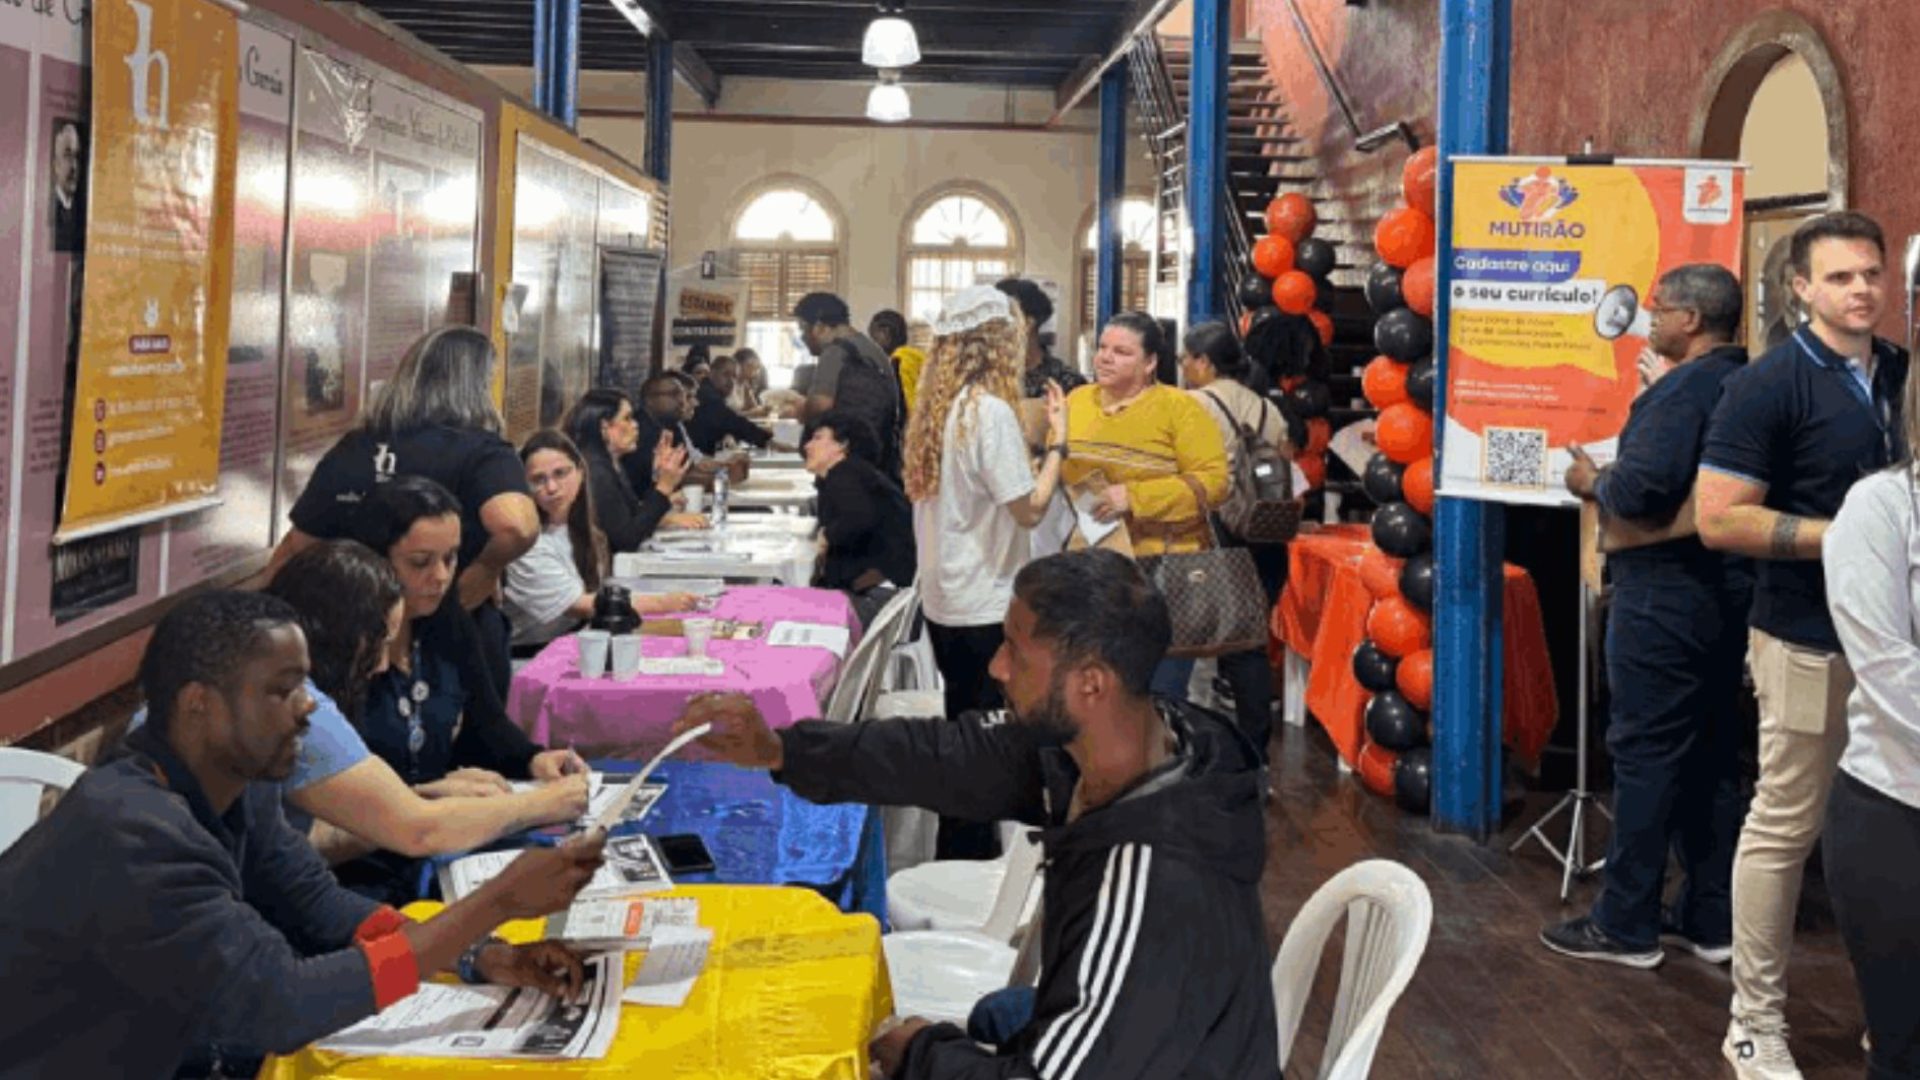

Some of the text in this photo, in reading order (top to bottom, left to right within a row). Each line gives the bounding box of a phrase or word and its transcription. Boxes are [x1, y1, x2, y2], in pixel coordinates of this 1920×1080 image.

[1489, 219, 1586, 239] MUTIRÃO
[1454, 255, 1570, 275] Cadastre aqui
[1469, 286, 1502, 299] seu
[1507, 286, 1597, 303] currículo!
